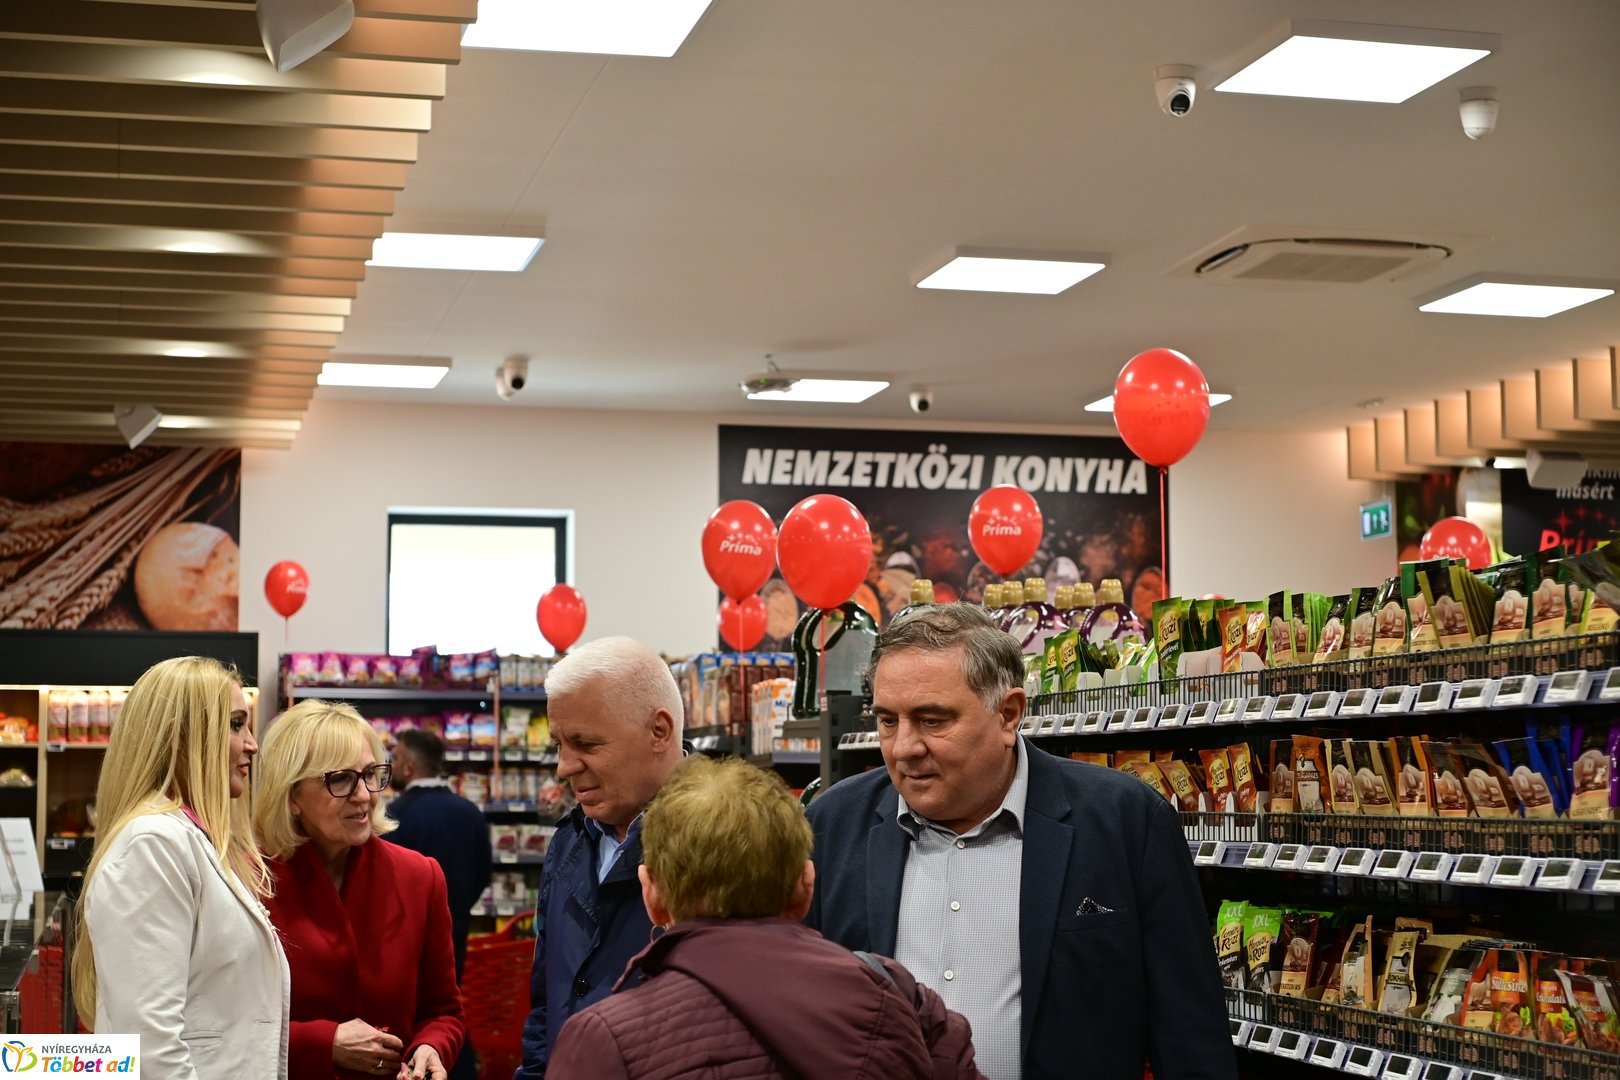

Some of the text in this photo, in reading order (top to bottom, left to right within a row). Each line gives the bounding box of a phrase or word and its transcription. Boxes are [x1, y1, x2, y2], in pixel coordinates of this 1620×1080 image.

[742, 444, 1148, 495] NEMZETKÖZI KONYHA
[1224, 905, 1243, 918] XXL
[1252, 913, 1270, 928] XXL
